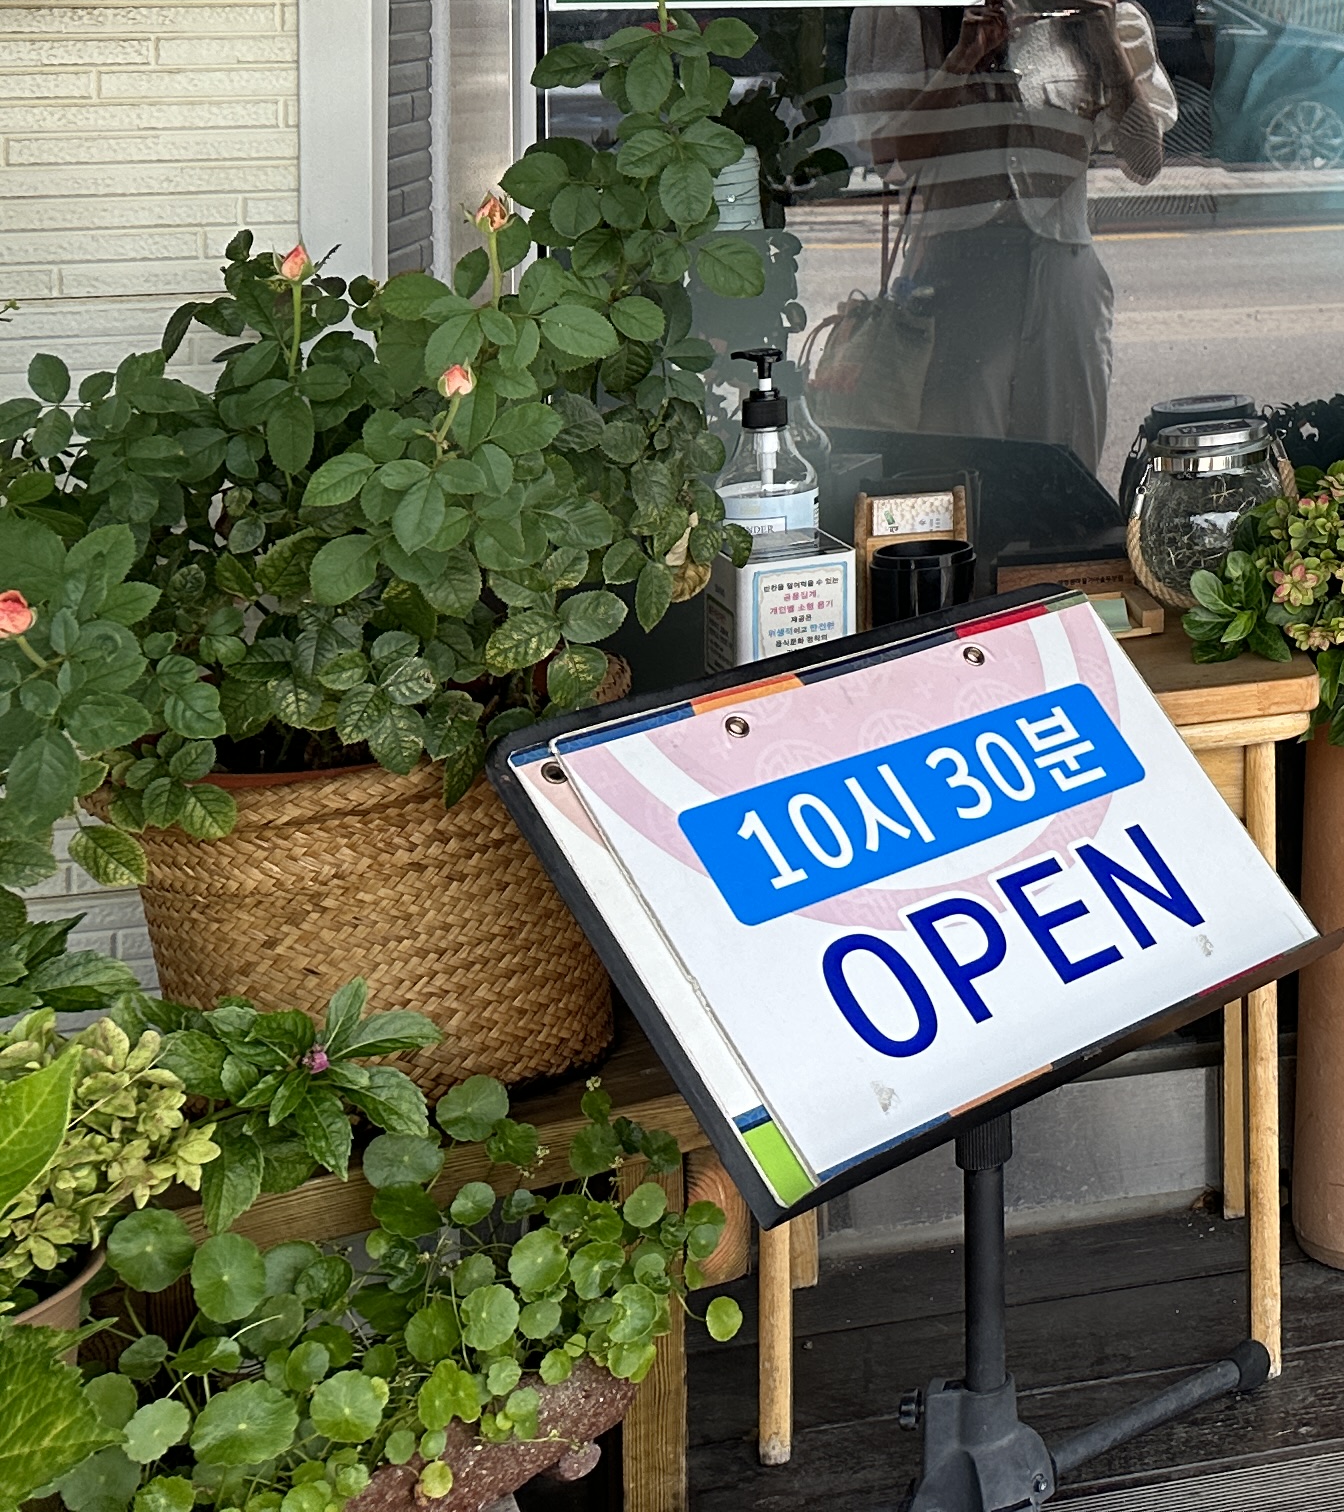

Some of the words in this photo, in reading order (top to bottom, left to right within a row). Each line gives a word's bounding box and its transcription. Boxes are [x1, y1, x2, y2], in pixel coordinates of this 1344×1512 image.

[735, 766, 936, 891] 10시
[926, 704, 1107, 822] 30분
[820, 823, 1206, 1059] OPEN
